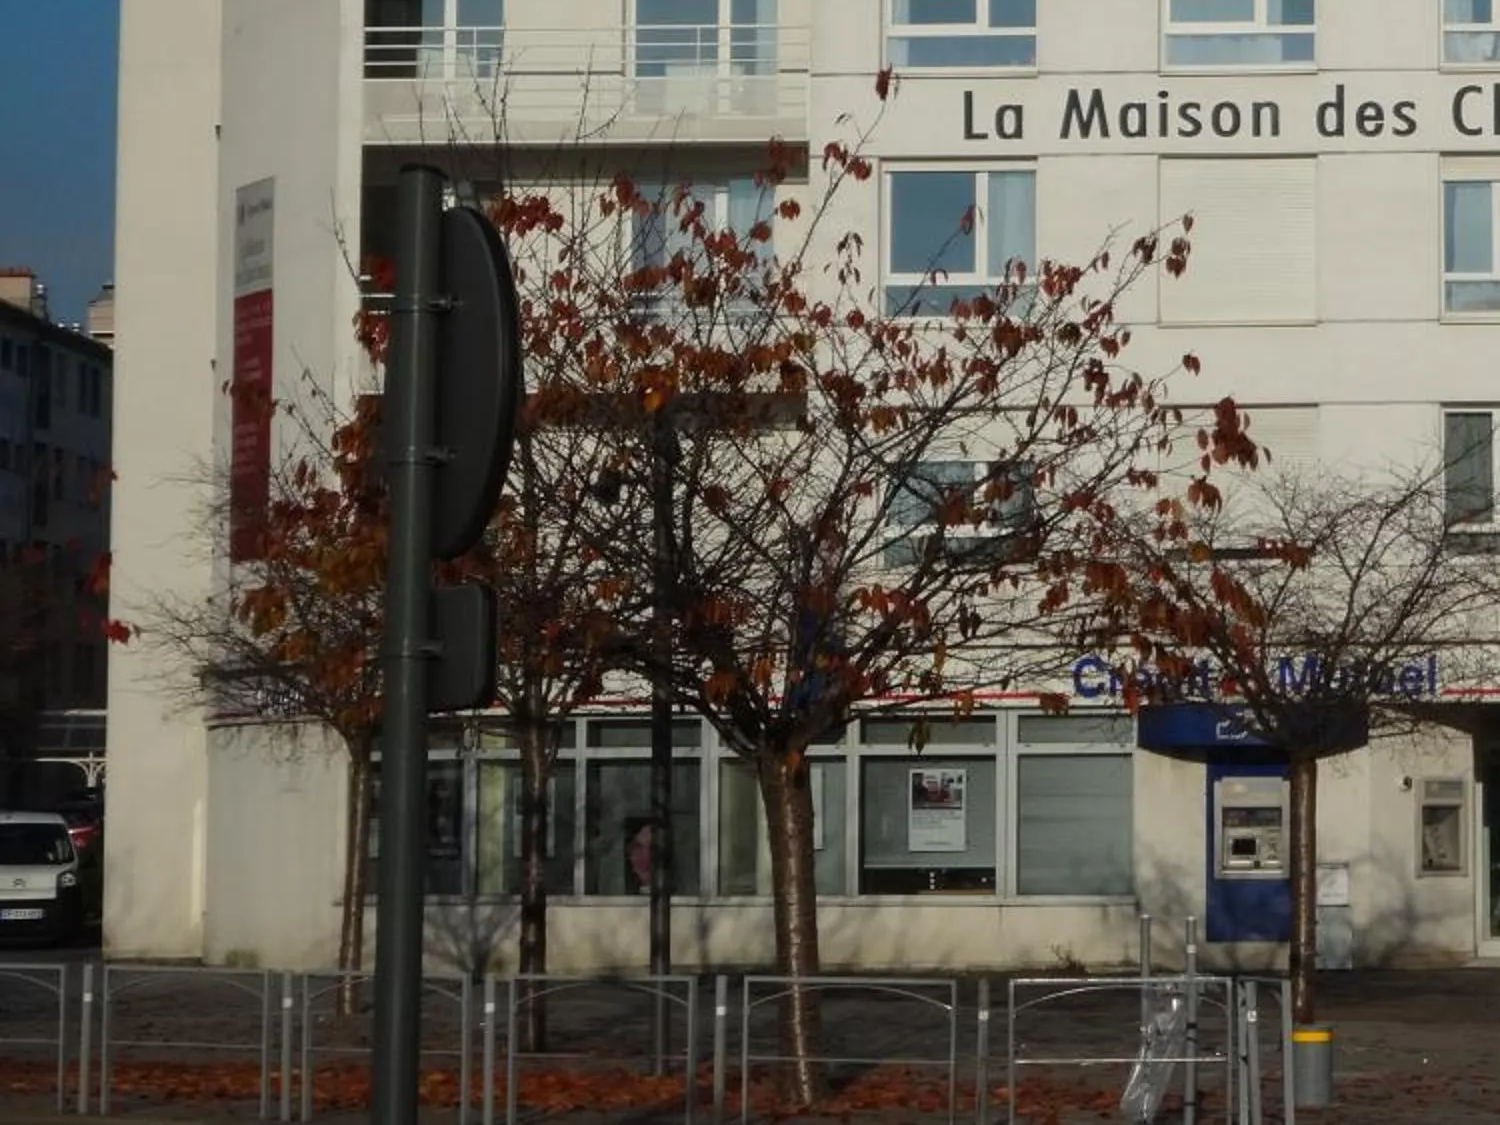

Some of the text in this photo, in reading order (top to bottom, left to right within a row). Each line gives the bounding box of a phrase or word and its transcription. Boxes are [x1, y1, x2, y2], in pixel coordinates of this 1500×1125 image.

[962, 89, 1024, 140] La
[1059, 87, 1281, 139] Maison
[1315, 83, 1418, 138] des
